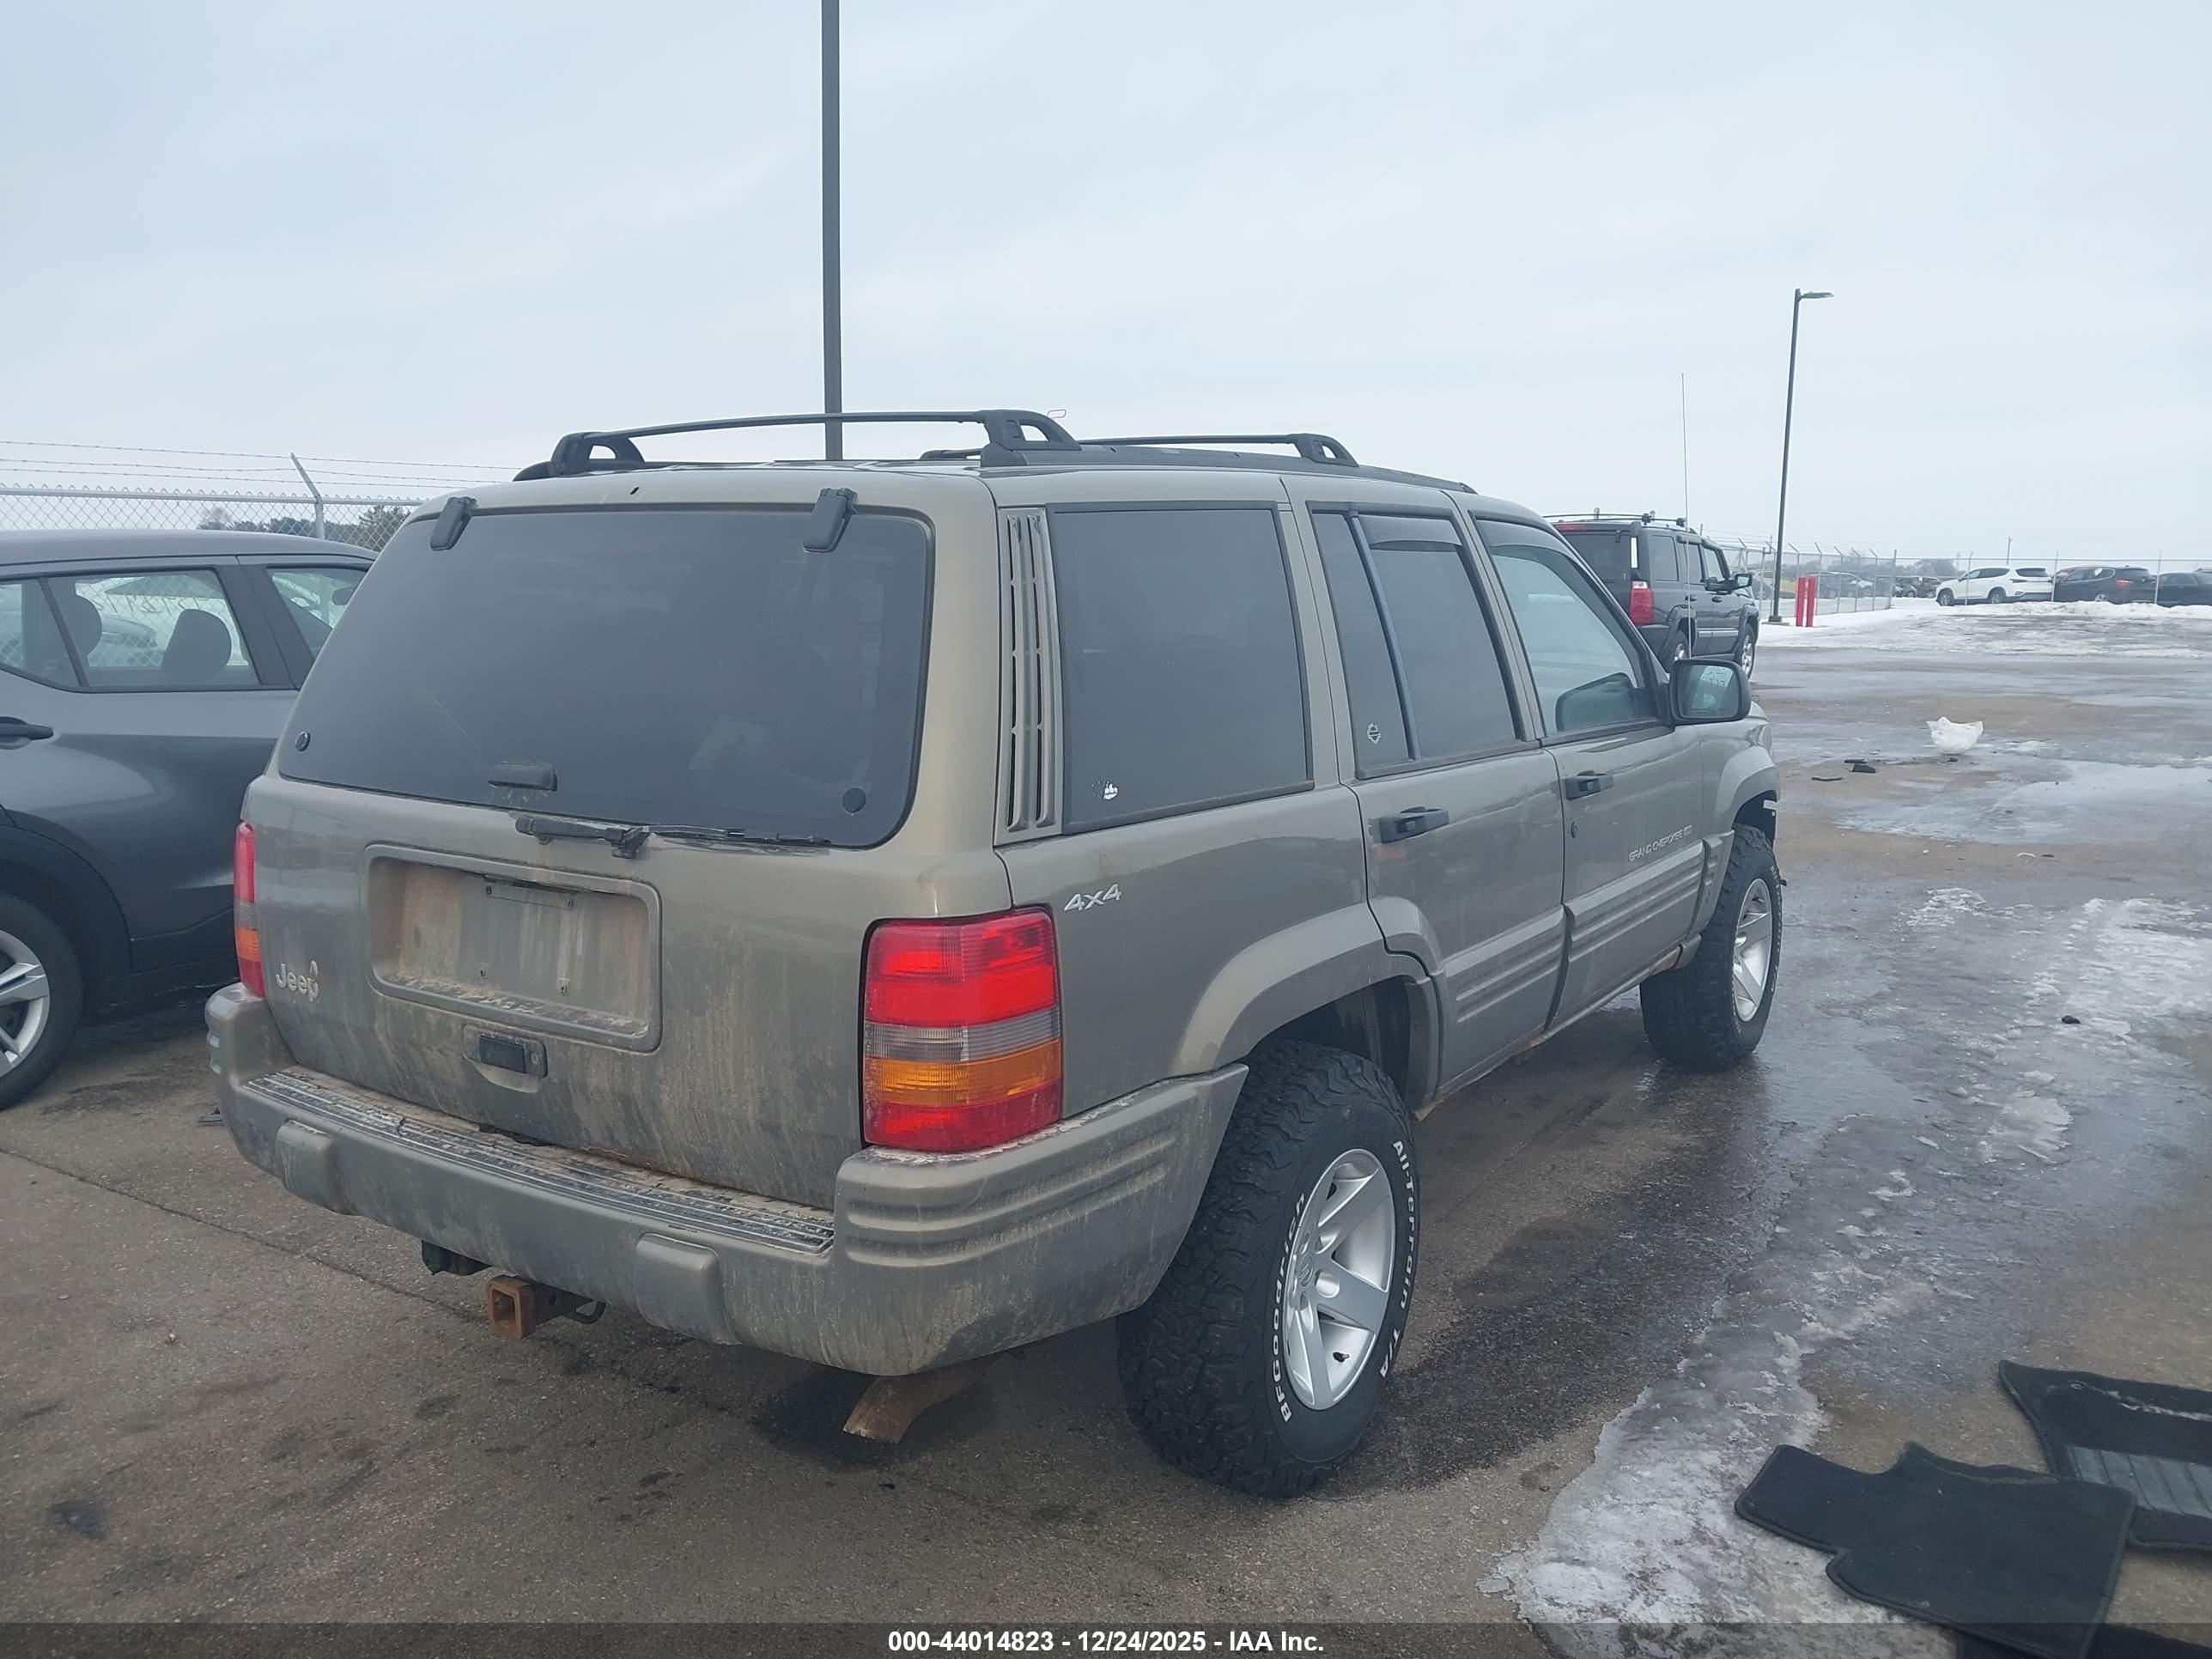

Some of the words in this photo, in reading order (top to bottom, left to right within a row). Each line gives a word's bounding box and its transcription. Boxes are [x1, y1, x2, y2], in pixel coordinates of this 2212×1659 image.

[275, 963, 319, 1003] Jeep
[1392, 1139, 1417, 1311] All-Terrain
[1271, 1193, 1305, 1423] BFGoodrich
[1379, 1328, 1402, 1380] T/A
